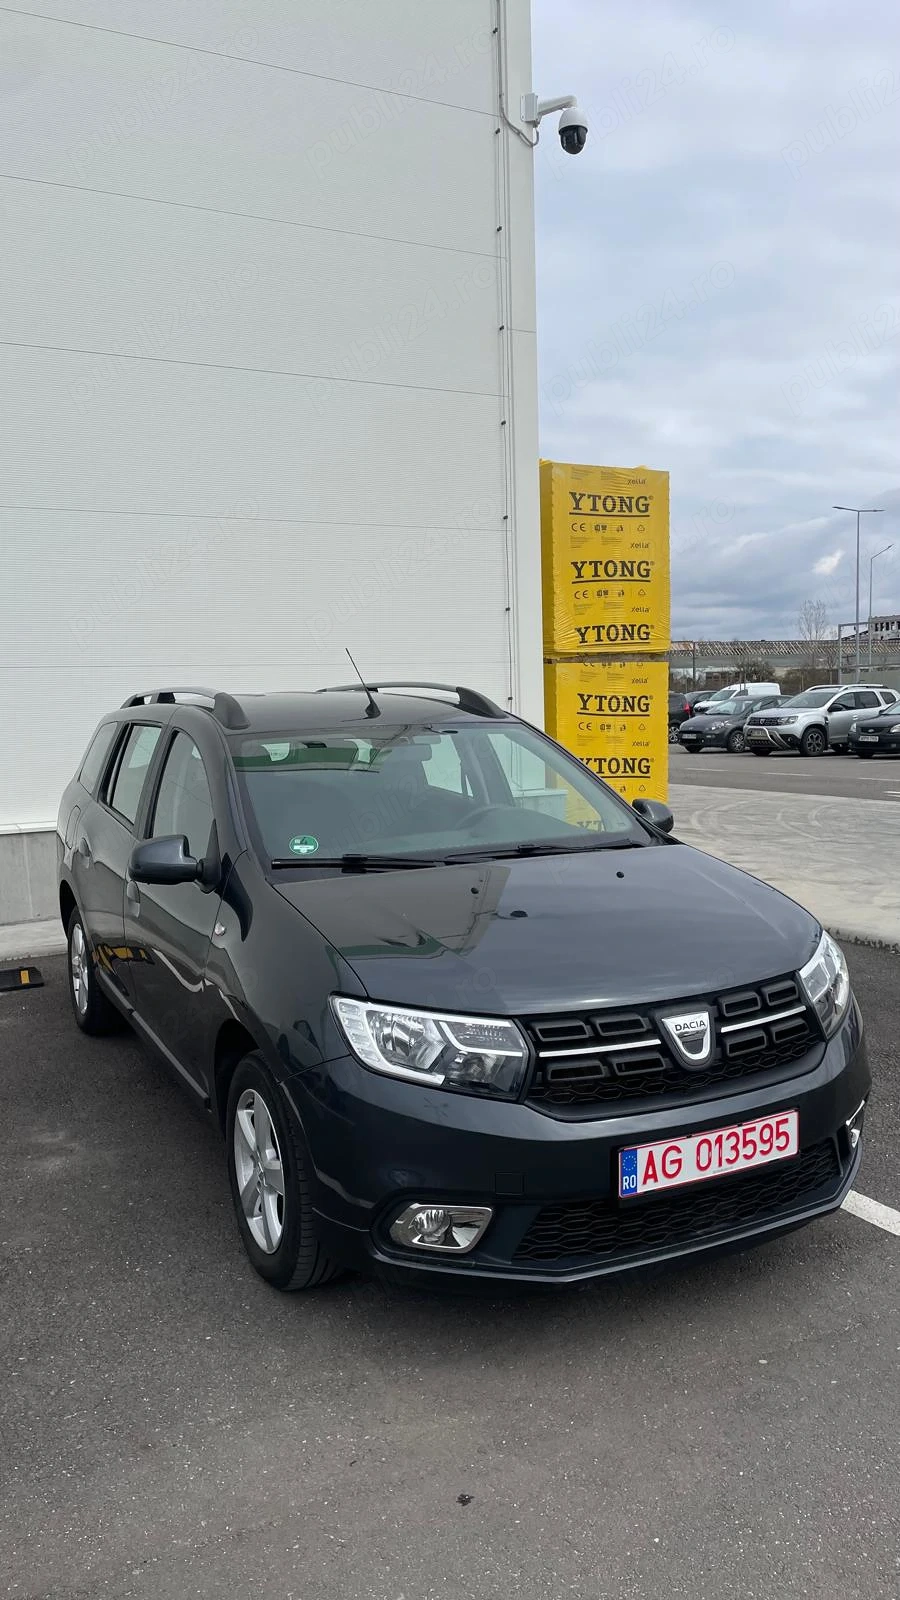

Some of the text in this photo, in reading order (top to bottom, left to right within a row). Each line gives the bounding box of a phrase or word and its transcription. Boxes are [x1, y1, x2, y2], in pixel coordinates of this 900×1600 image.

[674, 1019, 706, 1032] DACIA
[642, 1117, 790, 1186] AG 013595
[622, 1174, 636, 1190] RO
